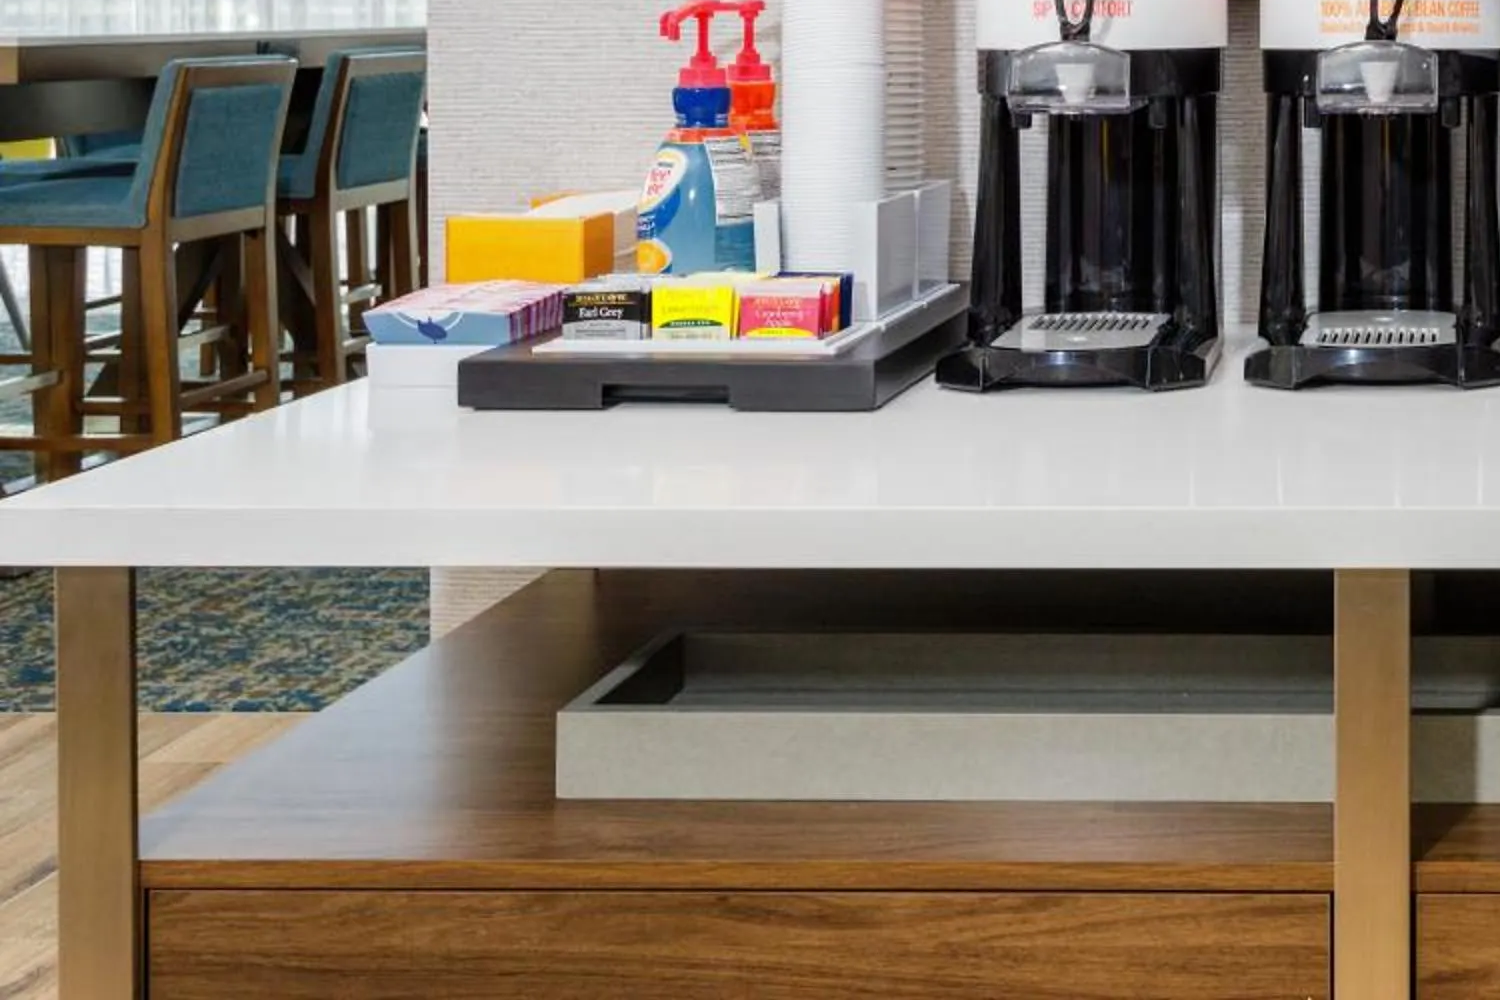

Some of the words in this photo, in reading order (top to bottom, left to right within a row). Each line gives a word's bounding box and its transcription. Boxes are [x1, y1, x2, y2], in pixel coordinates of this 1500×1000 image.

[1413, 0, 1443, 17] BEAN
[1447, 0, 1479, 17] COFFEE
[599, 306, 625, 319] Grey
